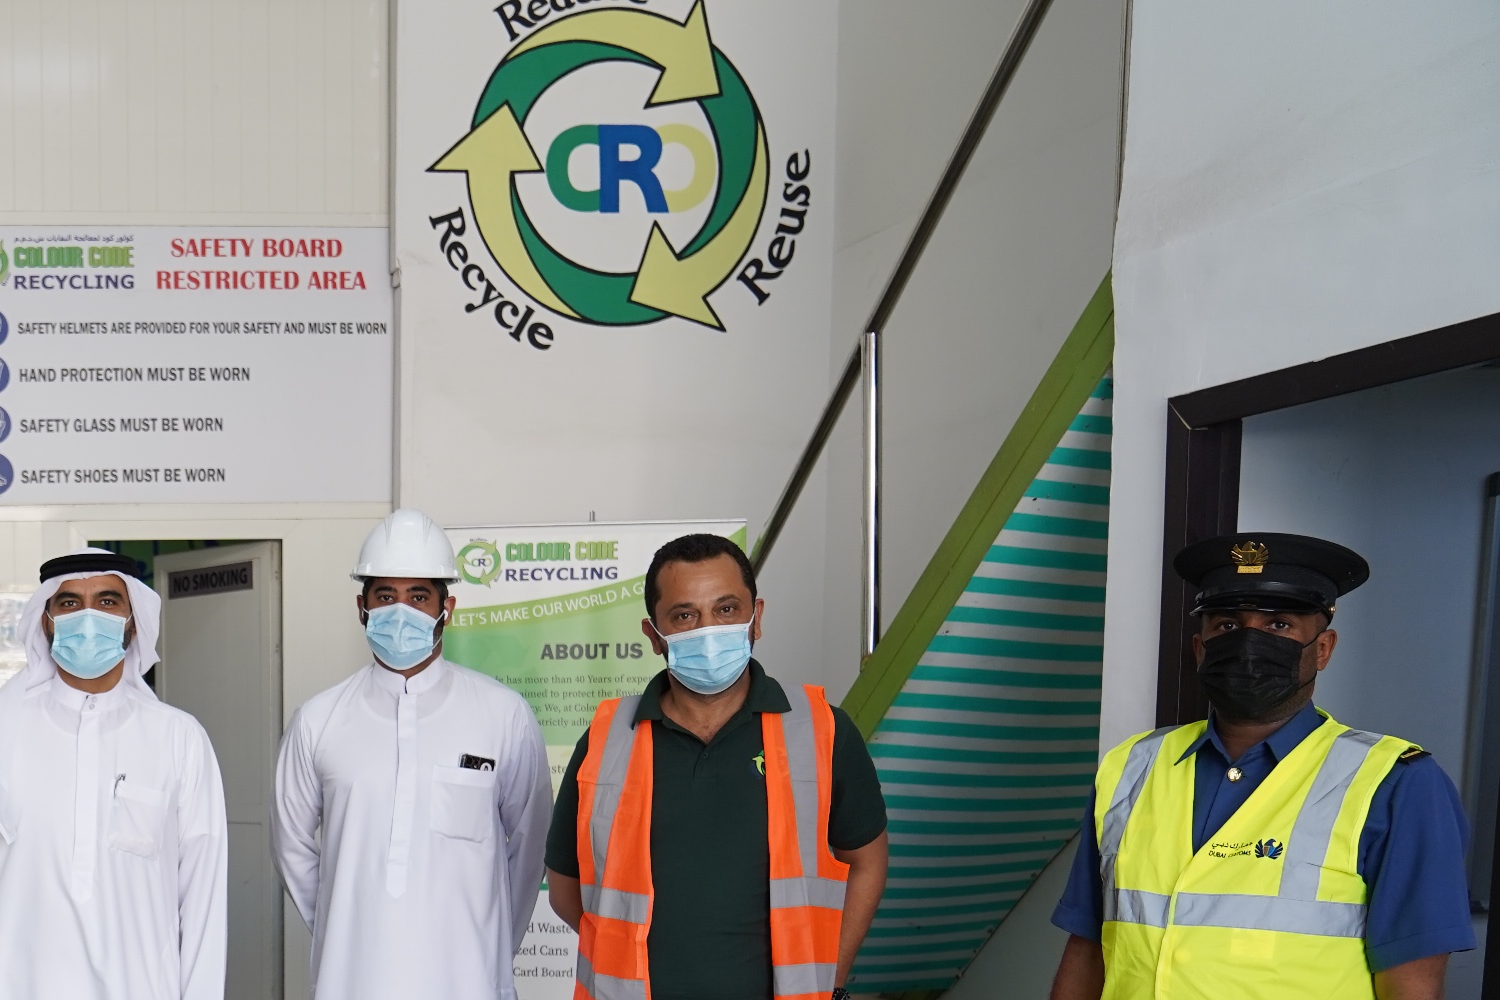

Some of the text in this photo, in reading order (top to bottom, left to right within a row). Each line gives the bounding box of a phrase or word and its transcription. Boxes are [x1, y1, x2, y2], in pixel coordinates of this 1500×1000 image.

[737, 148, 811, 306] Reuse
[170, 238, 343, 258] SAFETY BOARD
[13, 246, 135, 268] COLOUR CODE
[14, 274, 134, 290] RECYCLING
[156, 271, 367, 290] RESTRICTED AREA
[429, 207, 554, 351] Recycle
[17, 322, 387, 335] SAFETY HELMETS ARE PROVIDED FOR YOUR SAFETY AND MUST BE WORN
[19, 367, 250, 383] HAND PROTECTION MUST BE WORN
[20, 418, 223, 433] SAFETY GLASS MUST BE WORN
[21, 469, 226, 484] SAFETY SHOES MUST BE WORN
[506, 541, 618, 562] COLOUR CODE
[173, 567, 248, 593] NO SMOKING
[505, 567, 618, 582] RECYCLING
[490, 606, 529, 623] MAKE
[533, 602, 563, 618] OUR
[565, 590, 617, 612] WORLD
[621, 586, 631, 598] A
[540, 643, 643, 660] ABOUT US
[506, 675, 522, 684] has
[552, 675, 572, 684] than
[575, 675, 585, 684] 40
[588, 675, 612, 684] Years
[614, 674, 625, 684] of
[550, 690, 560, 698] to
[562, 690, 595, 700] protect
[597, 688, 612, 698] the
[563, 704, 572, 712] at
[1208, 850, 1226, 858] DUBAI
[538, 923, 572, 934] Waste
[540, 945, 569, 956] Cans
[513, 967, 573, 978] Card Board
